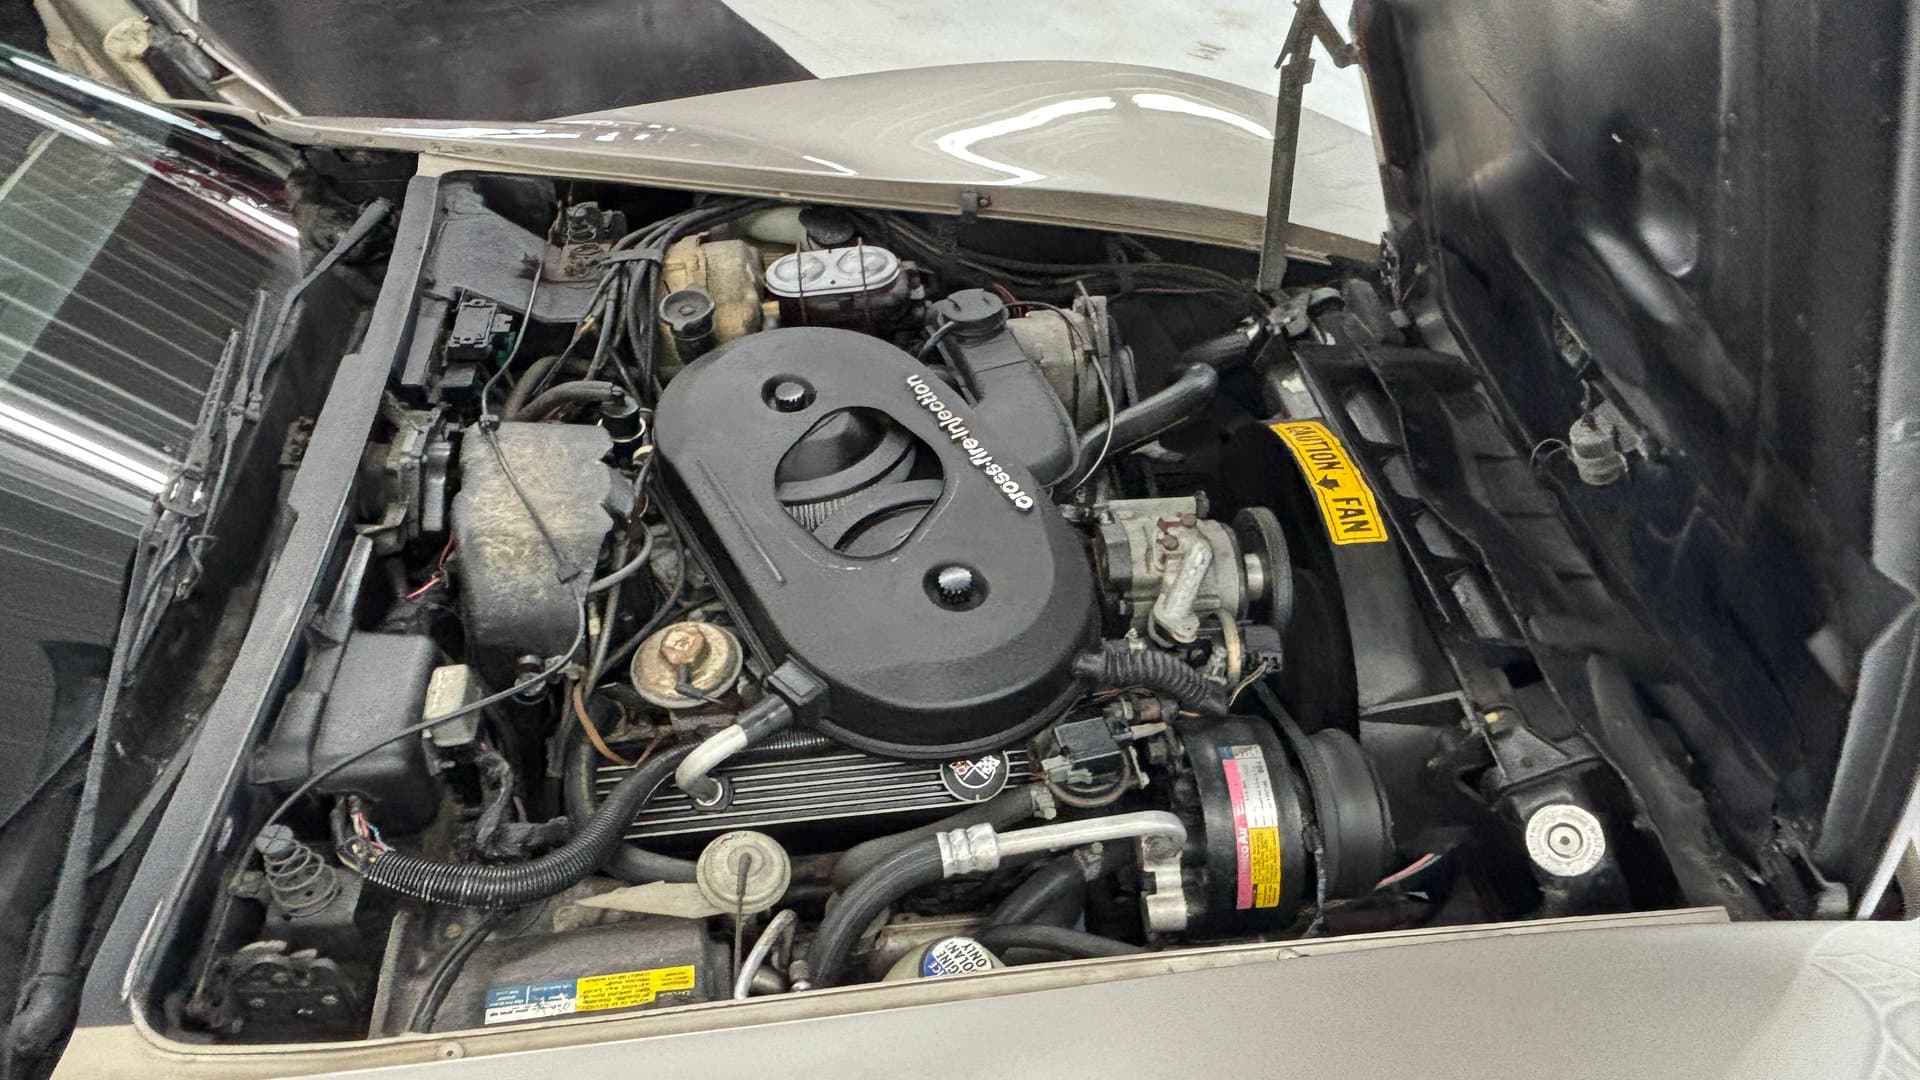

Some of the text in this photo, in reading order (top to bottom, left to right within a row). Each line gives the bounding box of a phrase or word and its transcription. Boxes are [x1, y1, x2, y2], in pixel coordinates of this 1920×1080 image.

[1284, 425, 1374, 533] CAUTION FAN
[936, 951, 964, 975] GINE
[961, 943, 987, 968] ONLY
